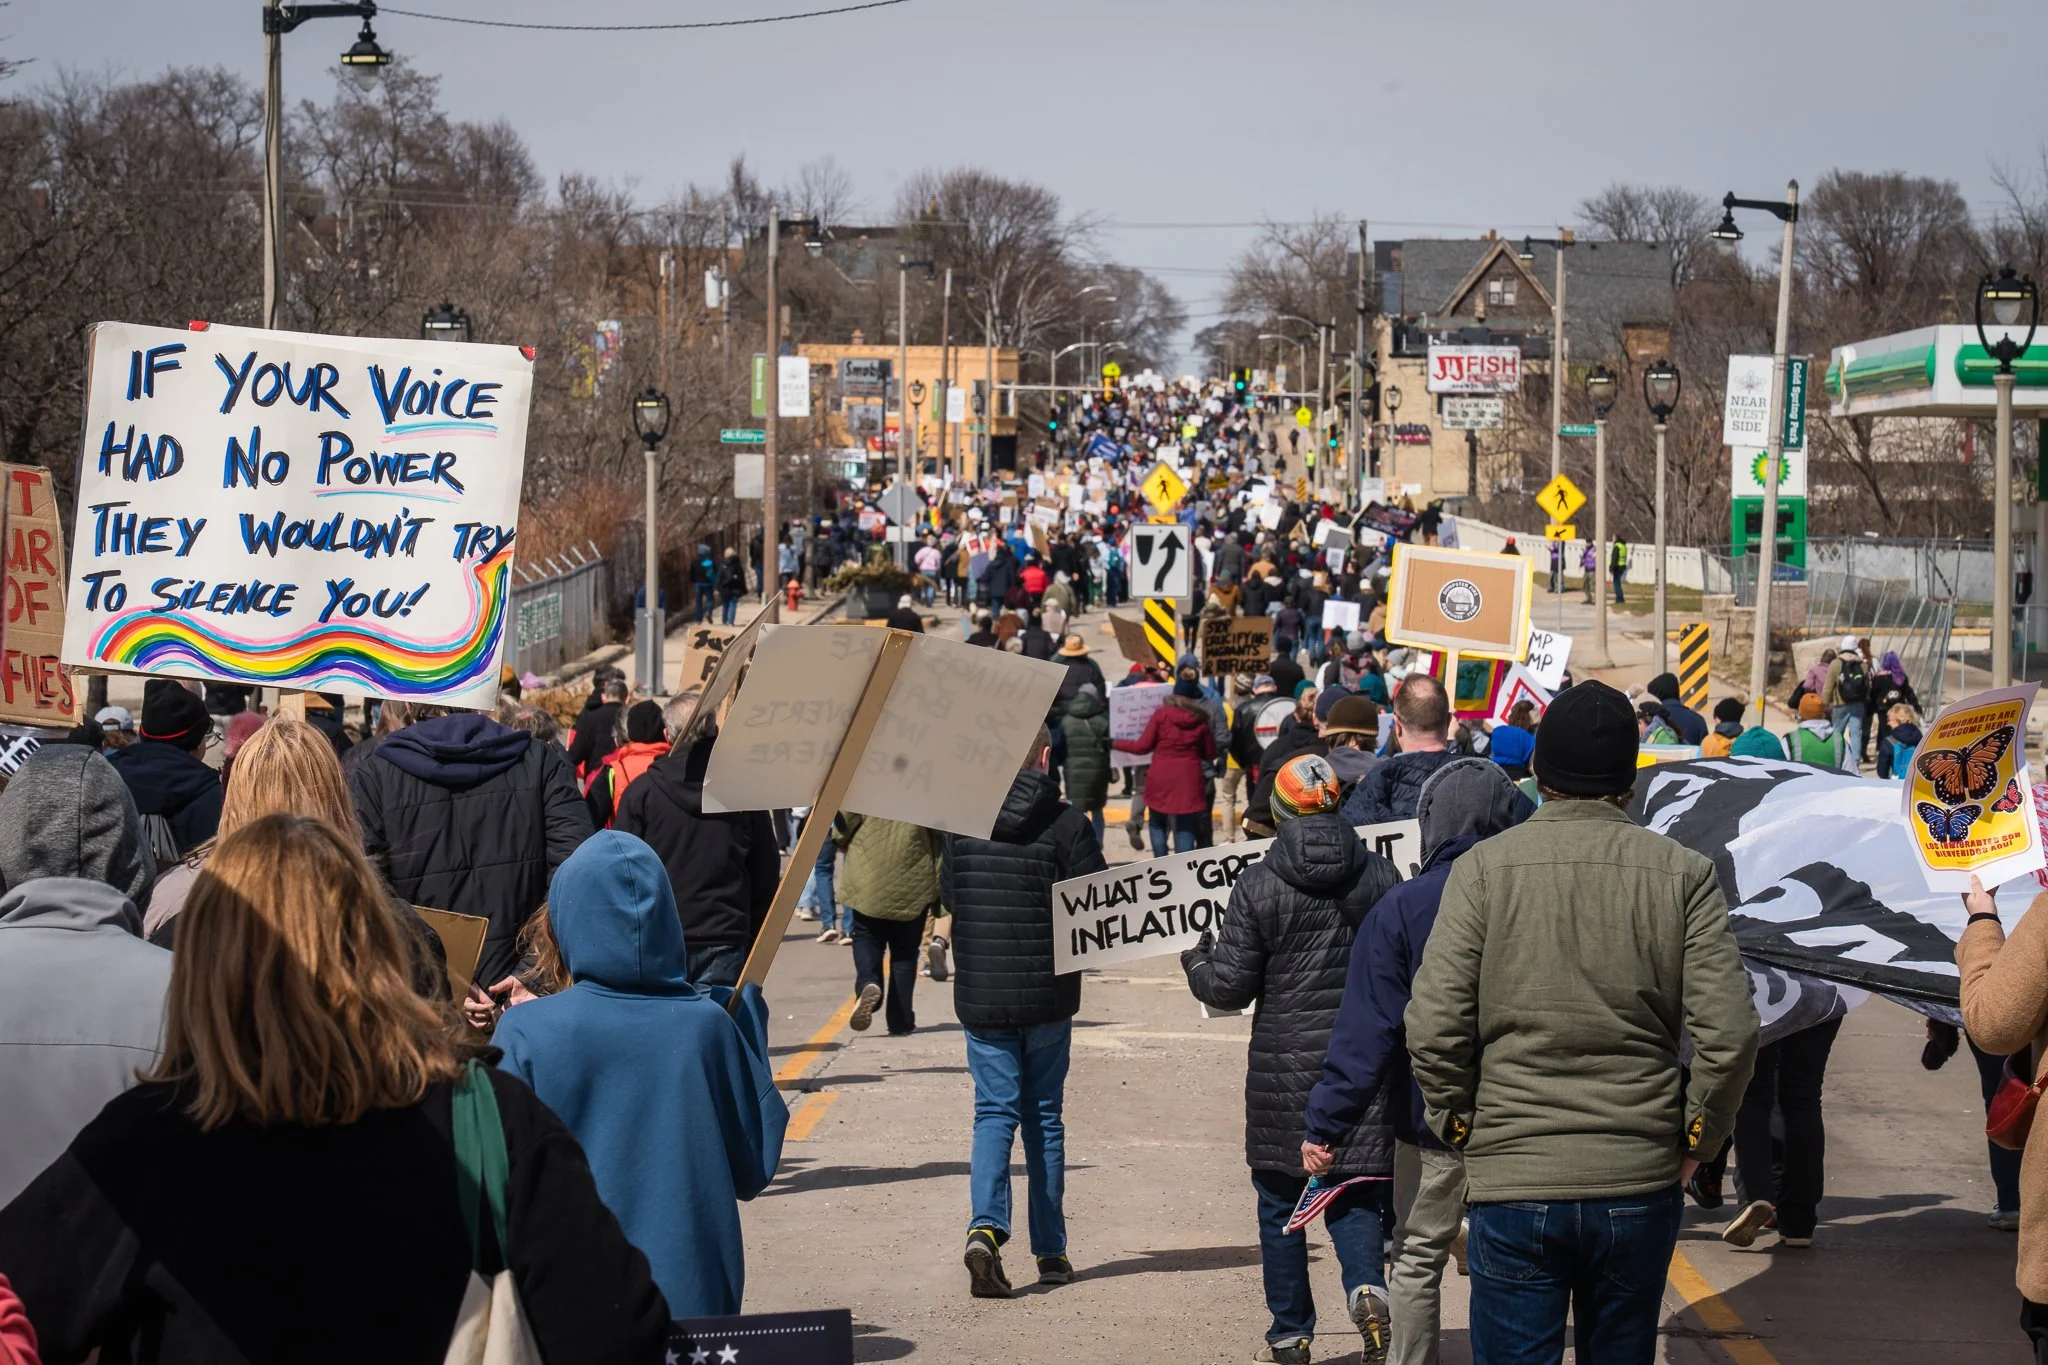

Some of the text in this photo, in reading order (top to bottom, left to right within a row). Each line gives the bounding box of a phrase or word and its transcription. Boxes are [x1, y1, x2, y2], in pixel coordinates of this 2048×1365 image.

[1467, 355, 1517, 373] FISH
[127, 343, 187, 400] IF
[214, 350, 351, 419] YOUR
[1731, 395, 1767, 407] NEAR
[1789, 362, 1802, 444] Cold Spring Park
[1729, 408, 1767, 420] WEST
[1732, 420, 1762, 432] SIDE
[99, 420, 185, 482] HAD
[316, 431, 465, 494] POWER
[88, 501, 518, 564] THEY WOULDN'T TRY
[82, 570, 128, 613] TO
[318, 577, 431, 623] YOU!
[1442, 581, 1478, 596] DUMPSTER FIRE
[1529, 631, 1553, 649] MP
[1206, 645, 1260, 658] MIGRANTS
[1216, 657, 1270, 673] REFUGEES
[1526, 653, 1553, 672] MP
[1938, 709, 2016, 731] IMMIGRANTS ARE
[1938, 720, 2009, 739] WELCOME HERE
[1925, 832, 2021, 850] LOS INMIGRANTES SON
[1935, 846, 1988, 858] BIENVENIDOS
[1060, 867, 1172, 916] WHAT'S
